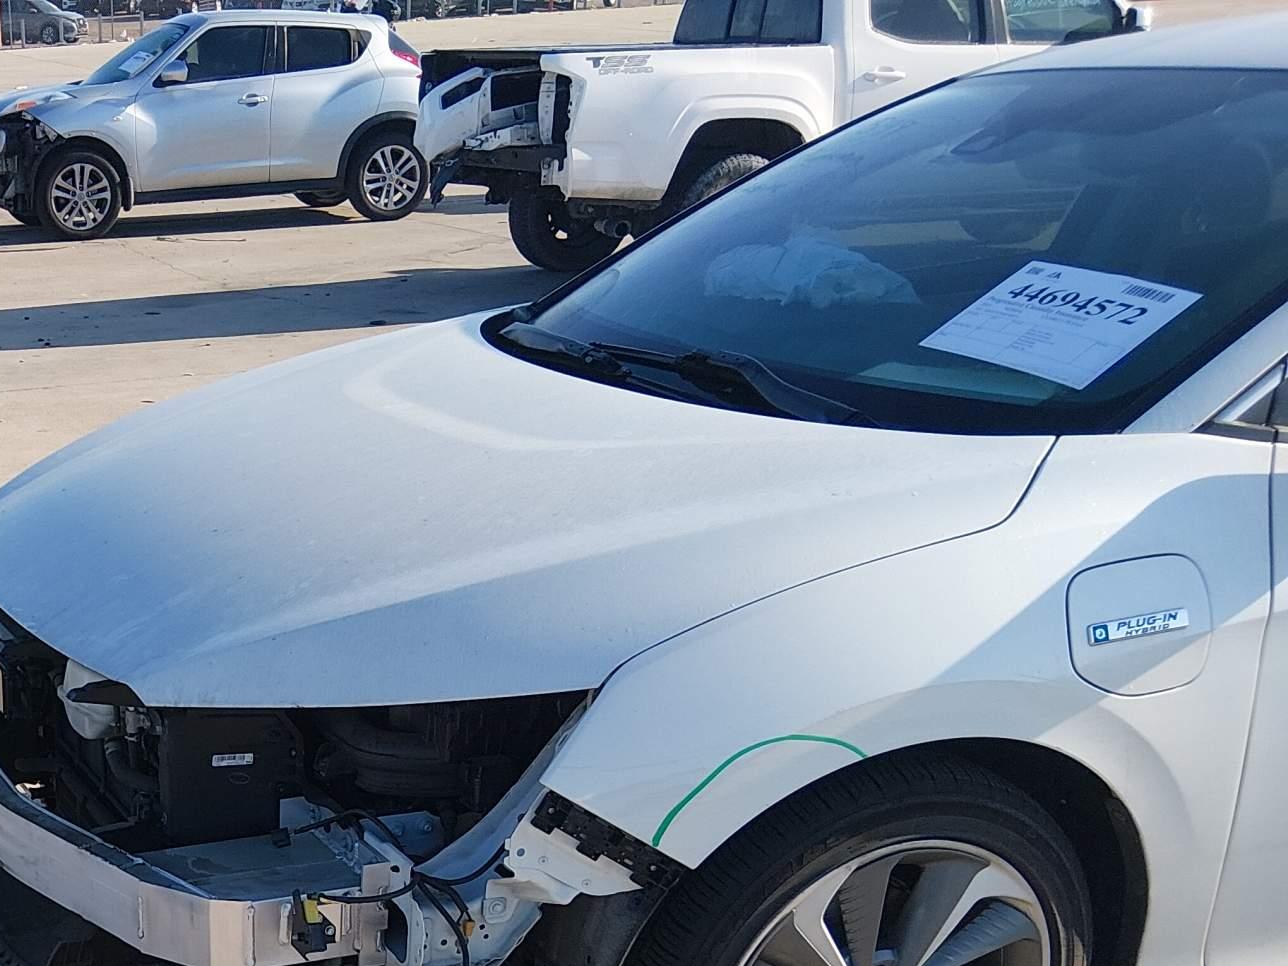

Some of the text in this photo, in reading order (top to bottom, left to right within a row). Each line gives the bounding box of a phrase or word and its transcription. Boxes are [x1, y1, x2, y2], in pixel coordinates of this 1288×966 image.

[1008, 283, 1148, 325] 44694572
[1116, 611, 1178, 631] PLUG-IN
[1125, 623, 1170, 637] HYBRID
